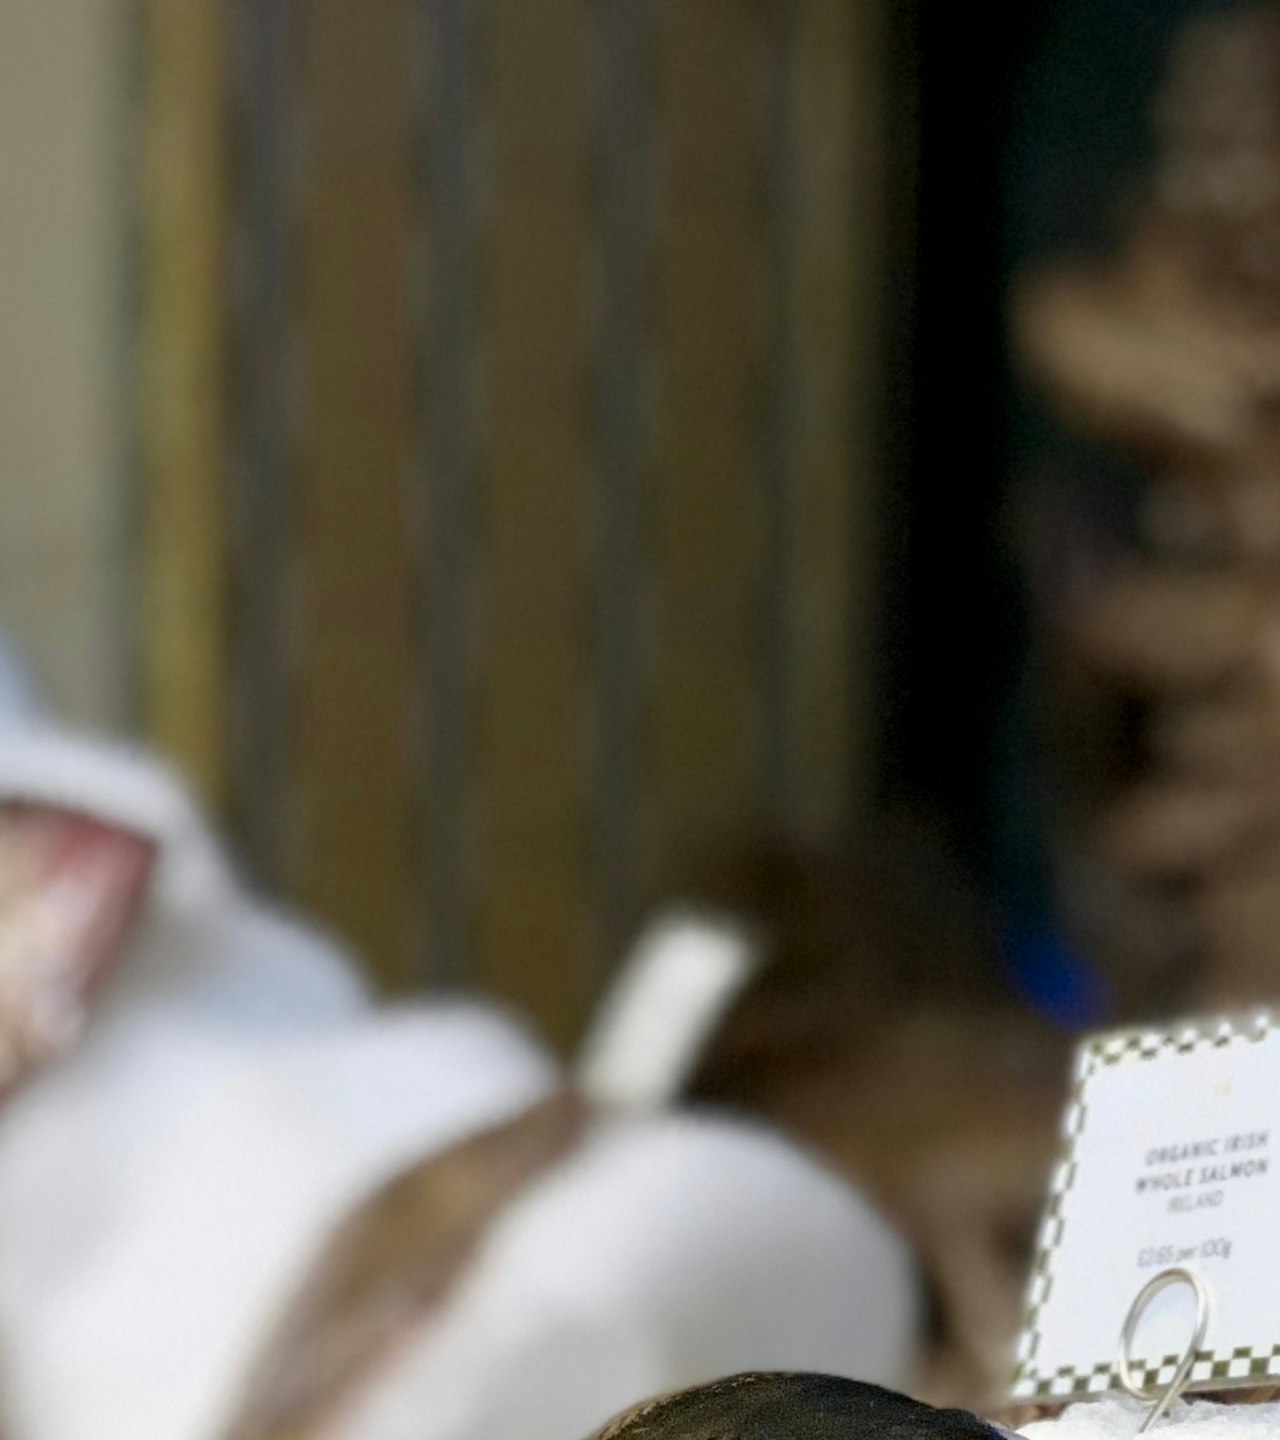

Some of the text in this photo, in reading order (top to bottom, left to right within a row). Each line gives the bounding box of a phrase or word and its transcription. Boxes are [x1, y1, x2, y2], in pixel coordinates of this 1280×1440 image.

[1145, 1130, 1269, 1166] ORGANIC IRISH
[1135, 1159, 1268, 1194] WHOLE SALMON
